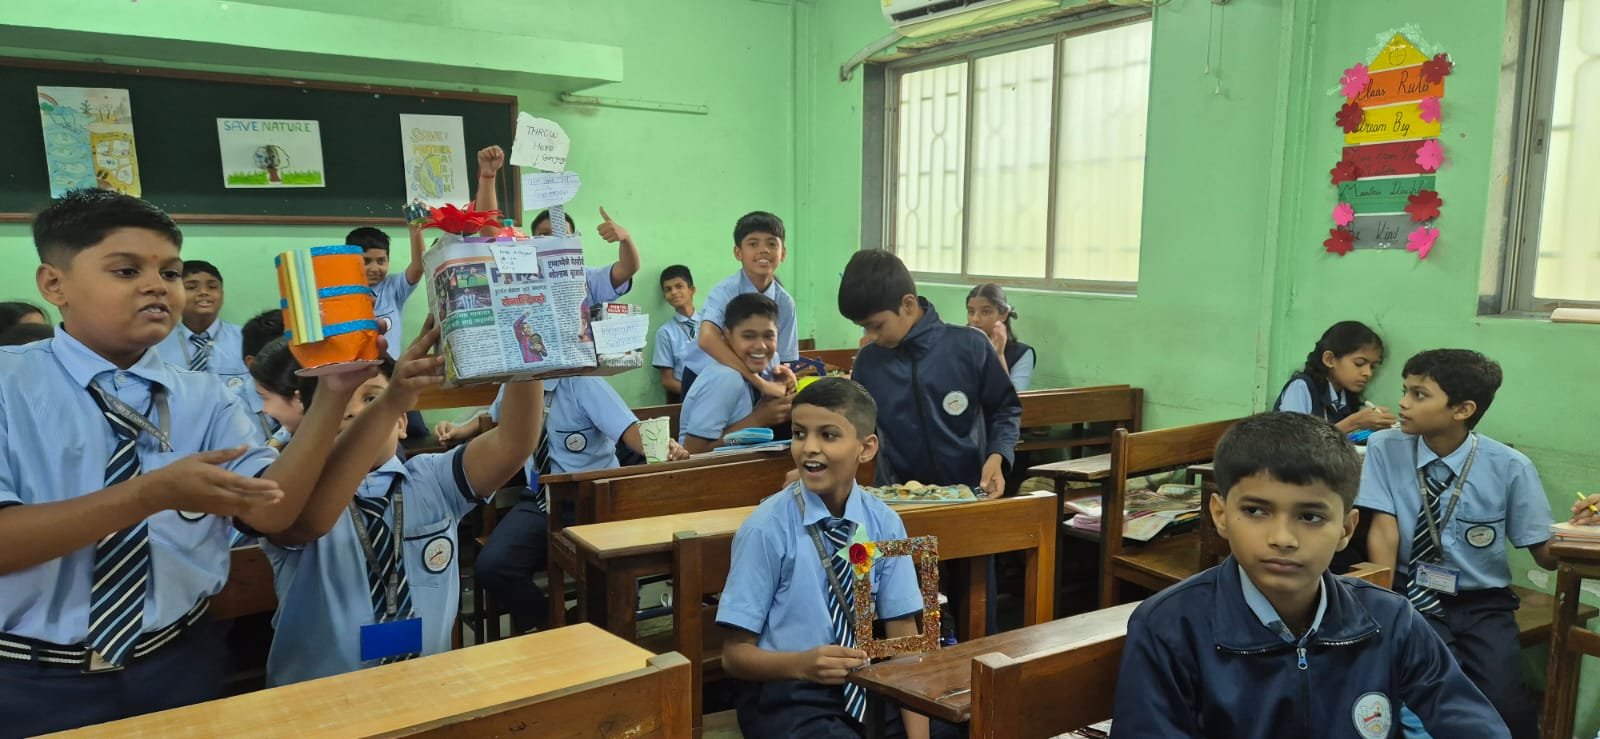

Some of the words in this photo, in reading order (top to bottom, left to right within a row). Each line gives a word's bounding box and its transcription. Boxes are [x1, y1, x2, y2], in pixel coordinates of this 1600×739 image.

[223, 120, 259, 131] SAVE
[261, 121, 312, 132] NATURE
[526, 125, 558, 138] THROW
[1393, 111, 1410, 136] Big
[1376, 221, 1399, 241] Kind
